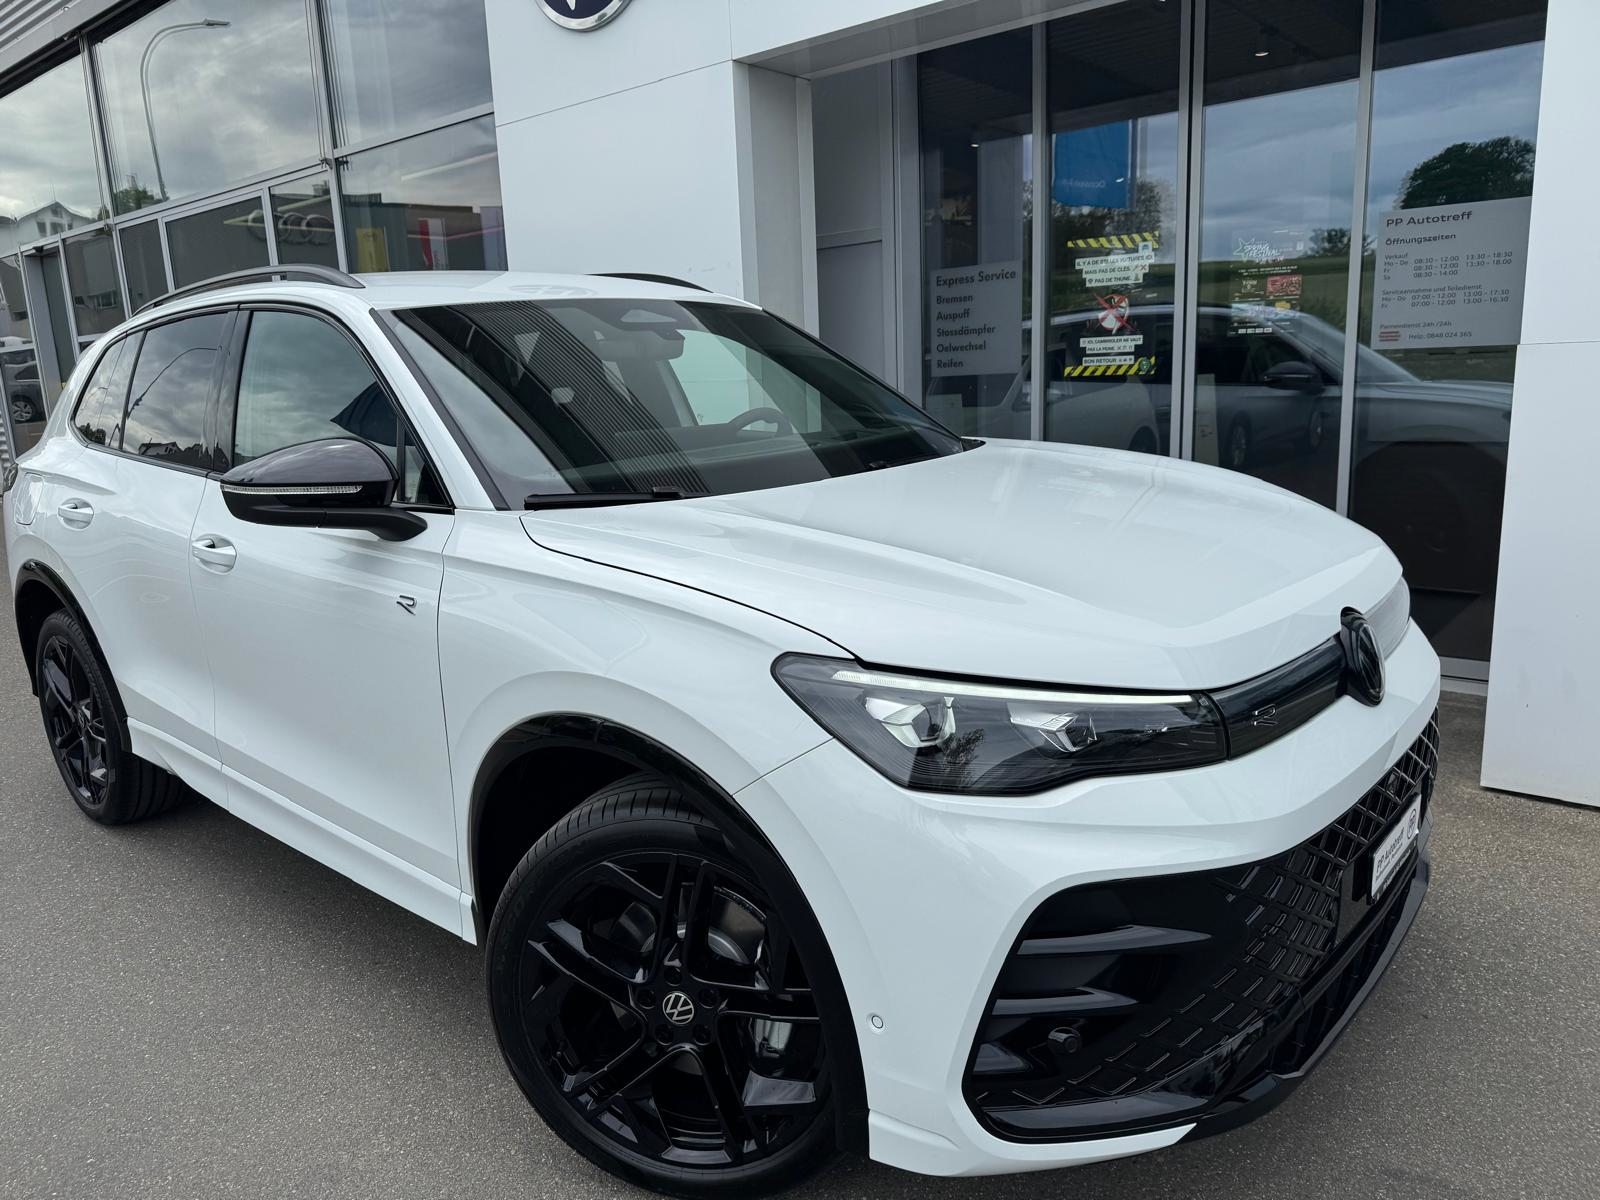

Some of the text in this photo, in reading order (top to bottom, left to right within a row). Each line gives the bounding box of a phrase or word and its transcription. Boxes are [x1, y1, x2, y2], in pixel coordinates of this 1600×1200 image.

[1386, 211, 1473, 228] PP Autotreff
[1385, 233, 1456, 246] Öffnungszeiten
[935, 269, 1017, 288] Express Service
[936, 294, 973, 305] Bremsen
[936, 308, 970, 322] Auspuff
[936, 324, 996, 338] Stossdämpfer
[936, 340, 987, 353] Oelwechsel
[936, 358, 964, 369] Reifen
